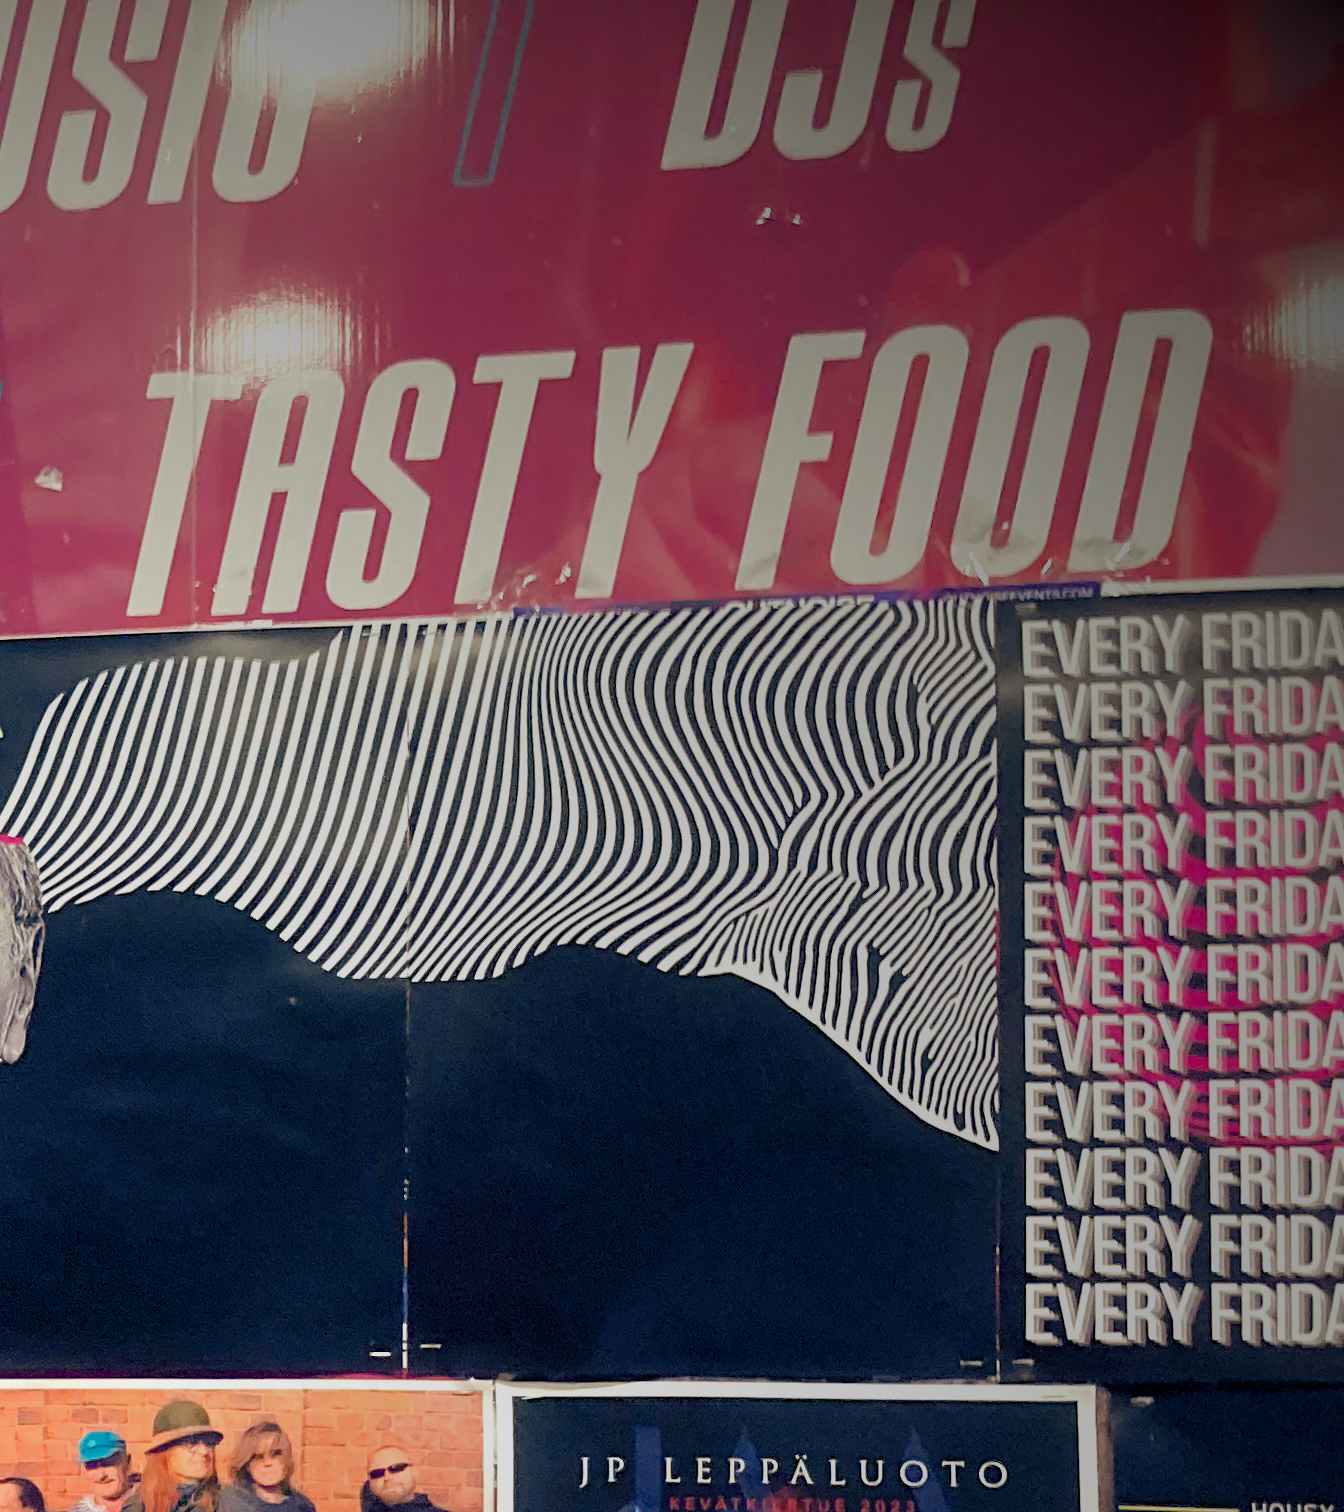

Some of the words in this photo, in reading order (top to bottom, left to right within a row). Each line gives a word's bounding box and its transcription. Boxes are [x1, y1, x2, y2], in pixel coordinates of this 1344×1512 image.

[127, 342, 694, 616] TASTY
[737, 309, 1216, 592] FOOD
[1022, 615, 1189, 677] EVERY
[1202, 608, 1344, 671] FRIDA
[1023, 680, 1190, 743] EVERY
[1203, 674, 1344, 736] FRIDA
[1023, 745, 1191, 809] EVERY
[1204, 741, 1344, 803] FRIDA
[1023, 812, 1192, 875] EVERY
[1206, 808, 1344, 869] FRIDA
[1023, 879, 1193, 942] EVERY
[1206, 875, 1344, 936] FRIDA
[1024, 947, 1194, 1009] EVERY
[1207, 943, 1344, 1005] FRIDA
[1024, 1011, 1192, 1075] EVERY
[1208, 1010, 1344, 1072] FRIDA
[1025, 1080, 1192, 1143] EVERY
[1209, 1077, 1344, 1139] FRIDA
[1025, 1147, 1198, 1211] EVERY
[1209, 1146, 1344, 1209] FRIDA
[1025, 1214, 1200, 1278] EVERY
[1210, 1214, 1344, 1278] FRIDA
[1025, 1282, 1200, 1346] EVERY
[1211, 1282, 1344, 1346] FRIDA
[578, 1456, 625, 1488] JP
[664, 1455, 1010, 1488] LEPPÄLUOTO
